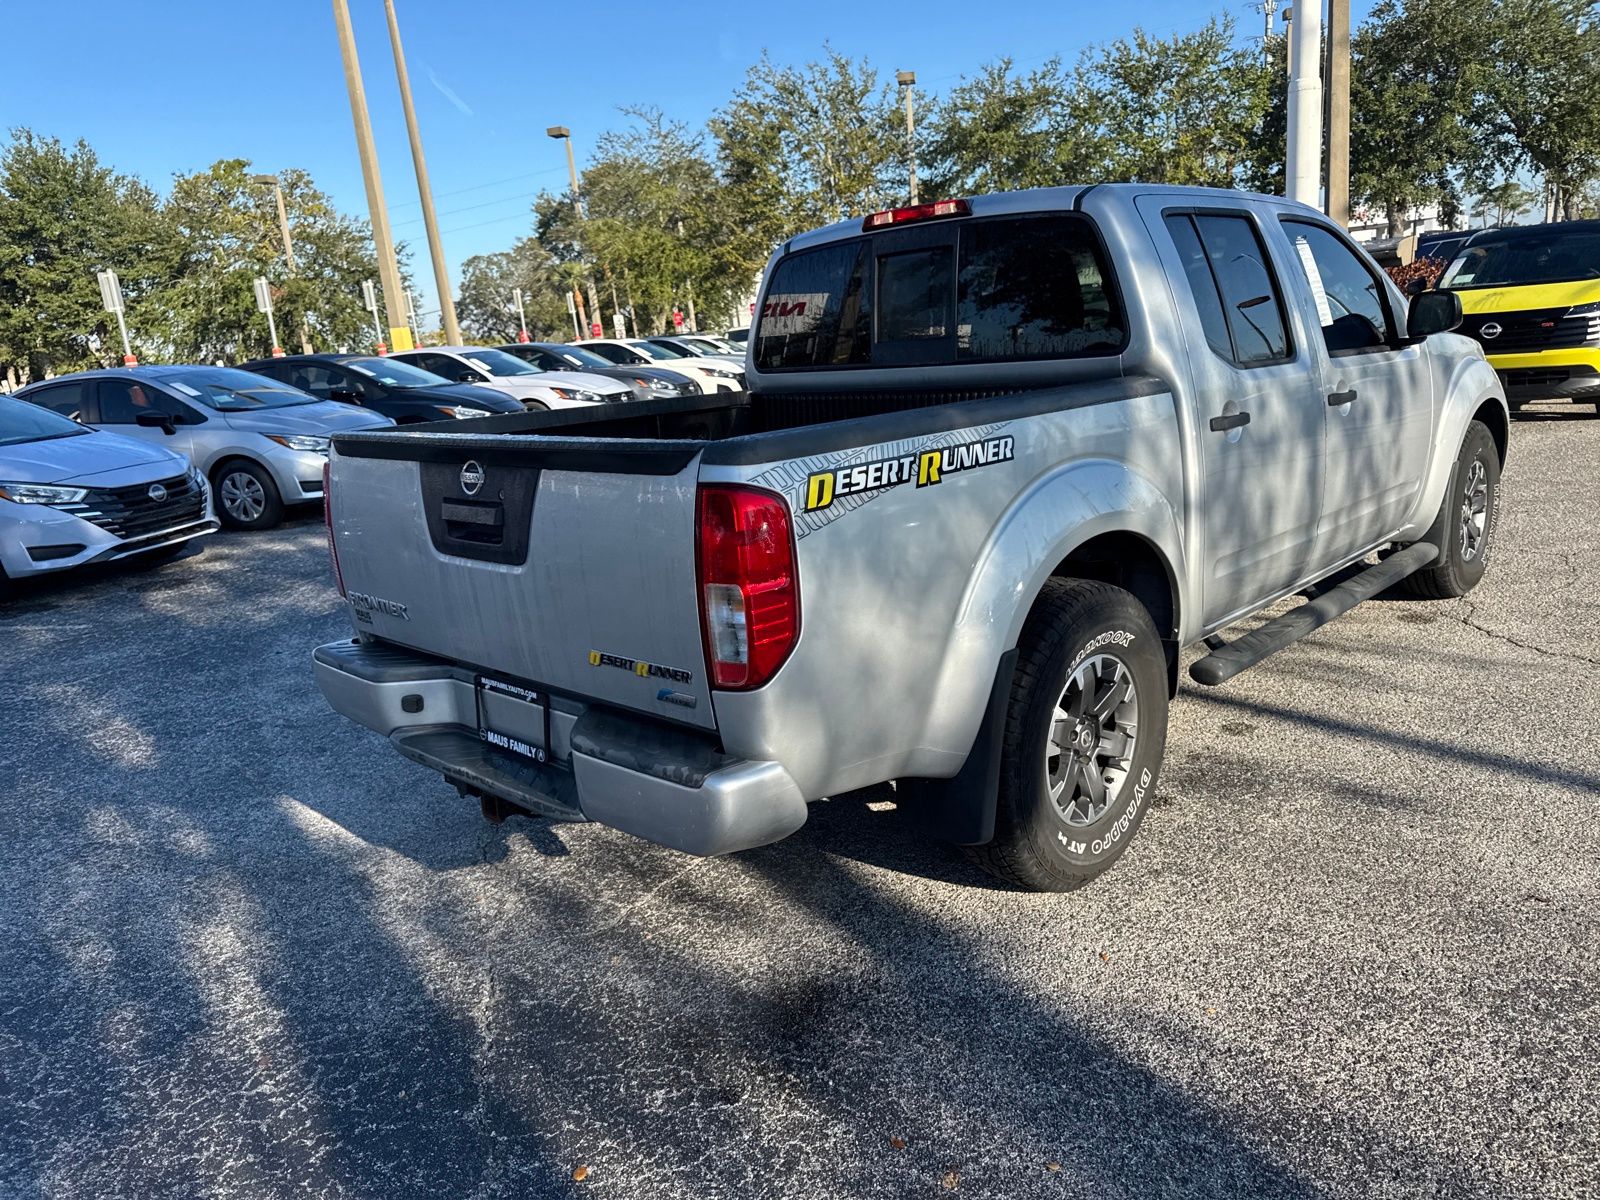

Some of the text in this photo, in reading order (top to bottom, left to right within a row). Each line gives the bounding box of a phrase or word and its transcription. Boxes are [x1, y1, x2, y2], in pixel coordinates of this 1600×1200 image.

[805, 435, 1014, 512] DESERT RUNNER
[348, 590, 410, 621] FRONTIER
[589, 650, 692, 684] DESERT RUNNER
[481, 677, 537, 699] MAUSFAMILYAUTO.COM
[487, 731, 536, 758] MAUS FAMILY
